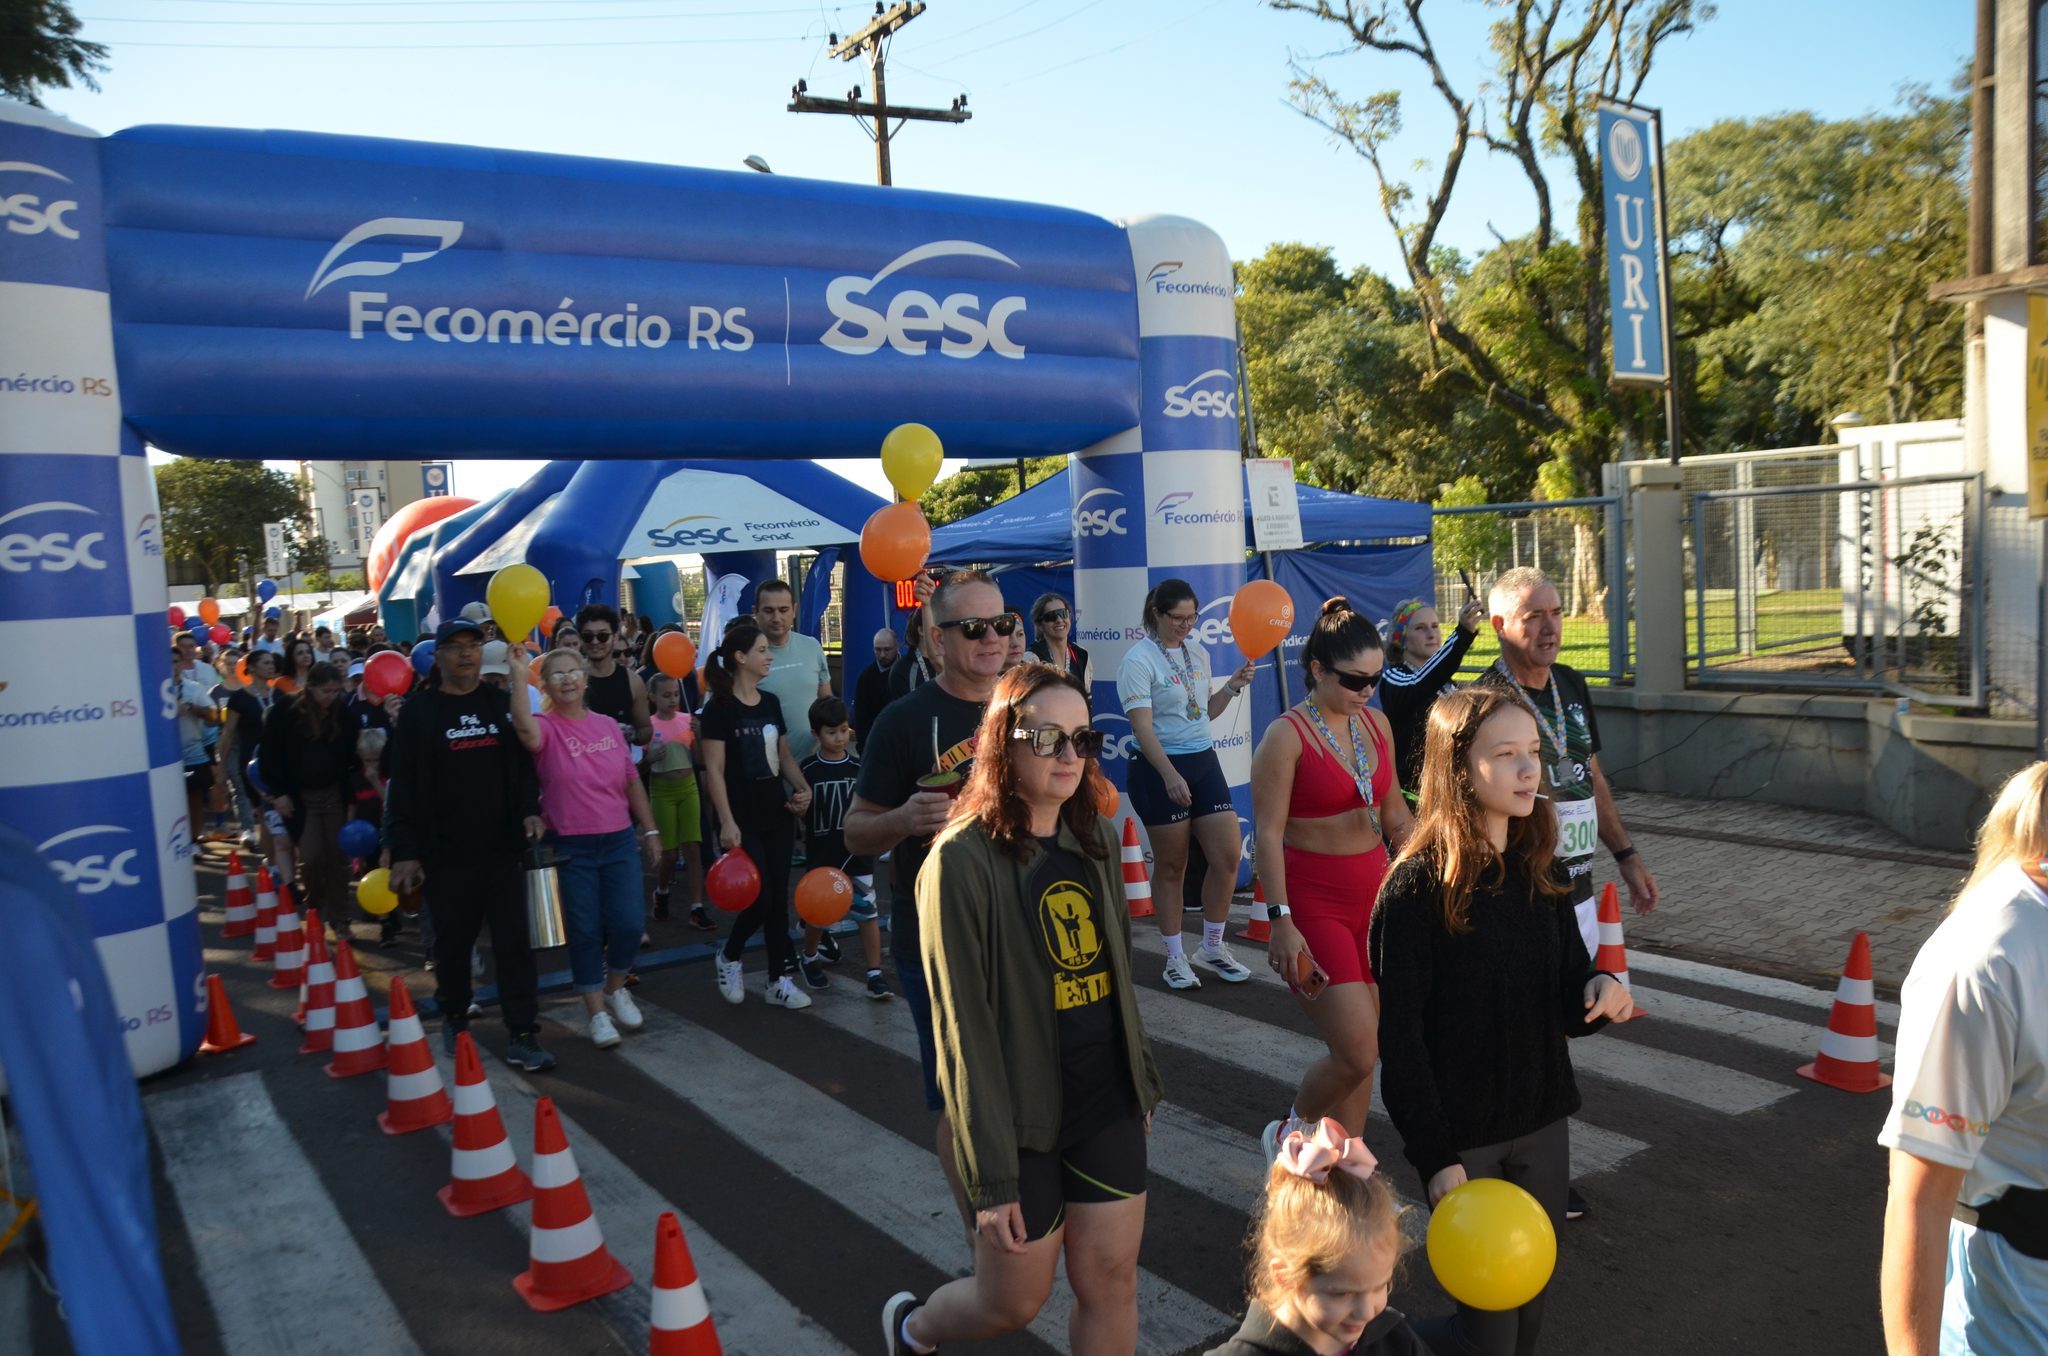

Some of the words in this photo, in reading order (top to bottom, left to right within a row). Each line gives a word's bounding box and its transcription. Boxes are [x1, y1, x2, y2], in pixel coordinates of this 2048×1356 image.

[1155, 281, 1227, 298] Fecomércio
[1615, 193, 1650, 369] URI
[348, 291, 671, 349] Fecomércio
[688, 305, 755, 352] RS
[818, 275, 1028, 360] Sesc
[81, 376, 113, 397] RS
[744, 518, 820, 531] Fecomércio
[1164, 510, 1236, 526] Fecomércio
[647, 526, 739, 548] Sesc
[1125, 627, 1145, 641] RS
[110, 699, 138, 718] RS
[1171, 810, 1189, 821] RUN
[146, 1004, 174, 1026] RS
